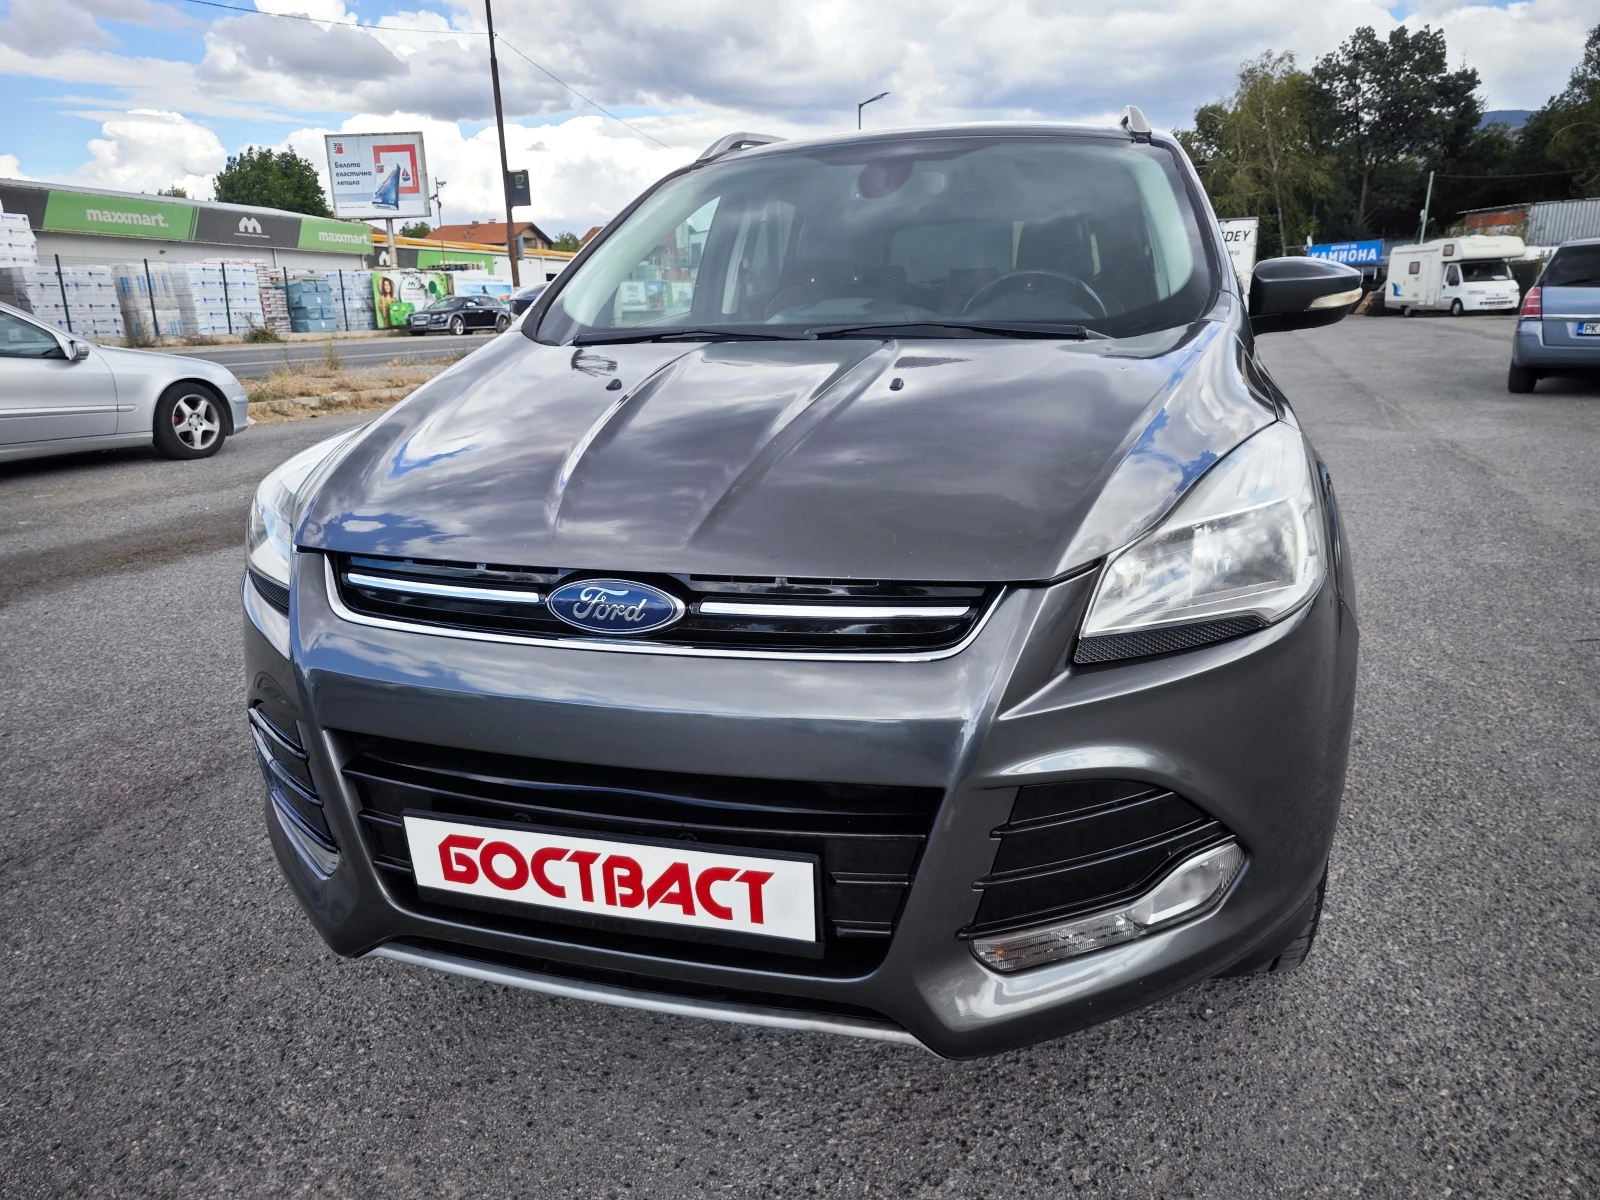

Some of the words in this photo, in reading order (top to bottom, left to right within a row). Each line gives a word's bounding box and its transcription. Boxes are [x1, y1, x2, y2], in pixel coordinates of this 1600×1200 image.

[86, 208, 169, 228] maxxmart.
[1222, 229, 1252, 242] DEY
[572, 586, 648, 622] Ford
[437, 833, 775, 925] БОСТВАСТ
